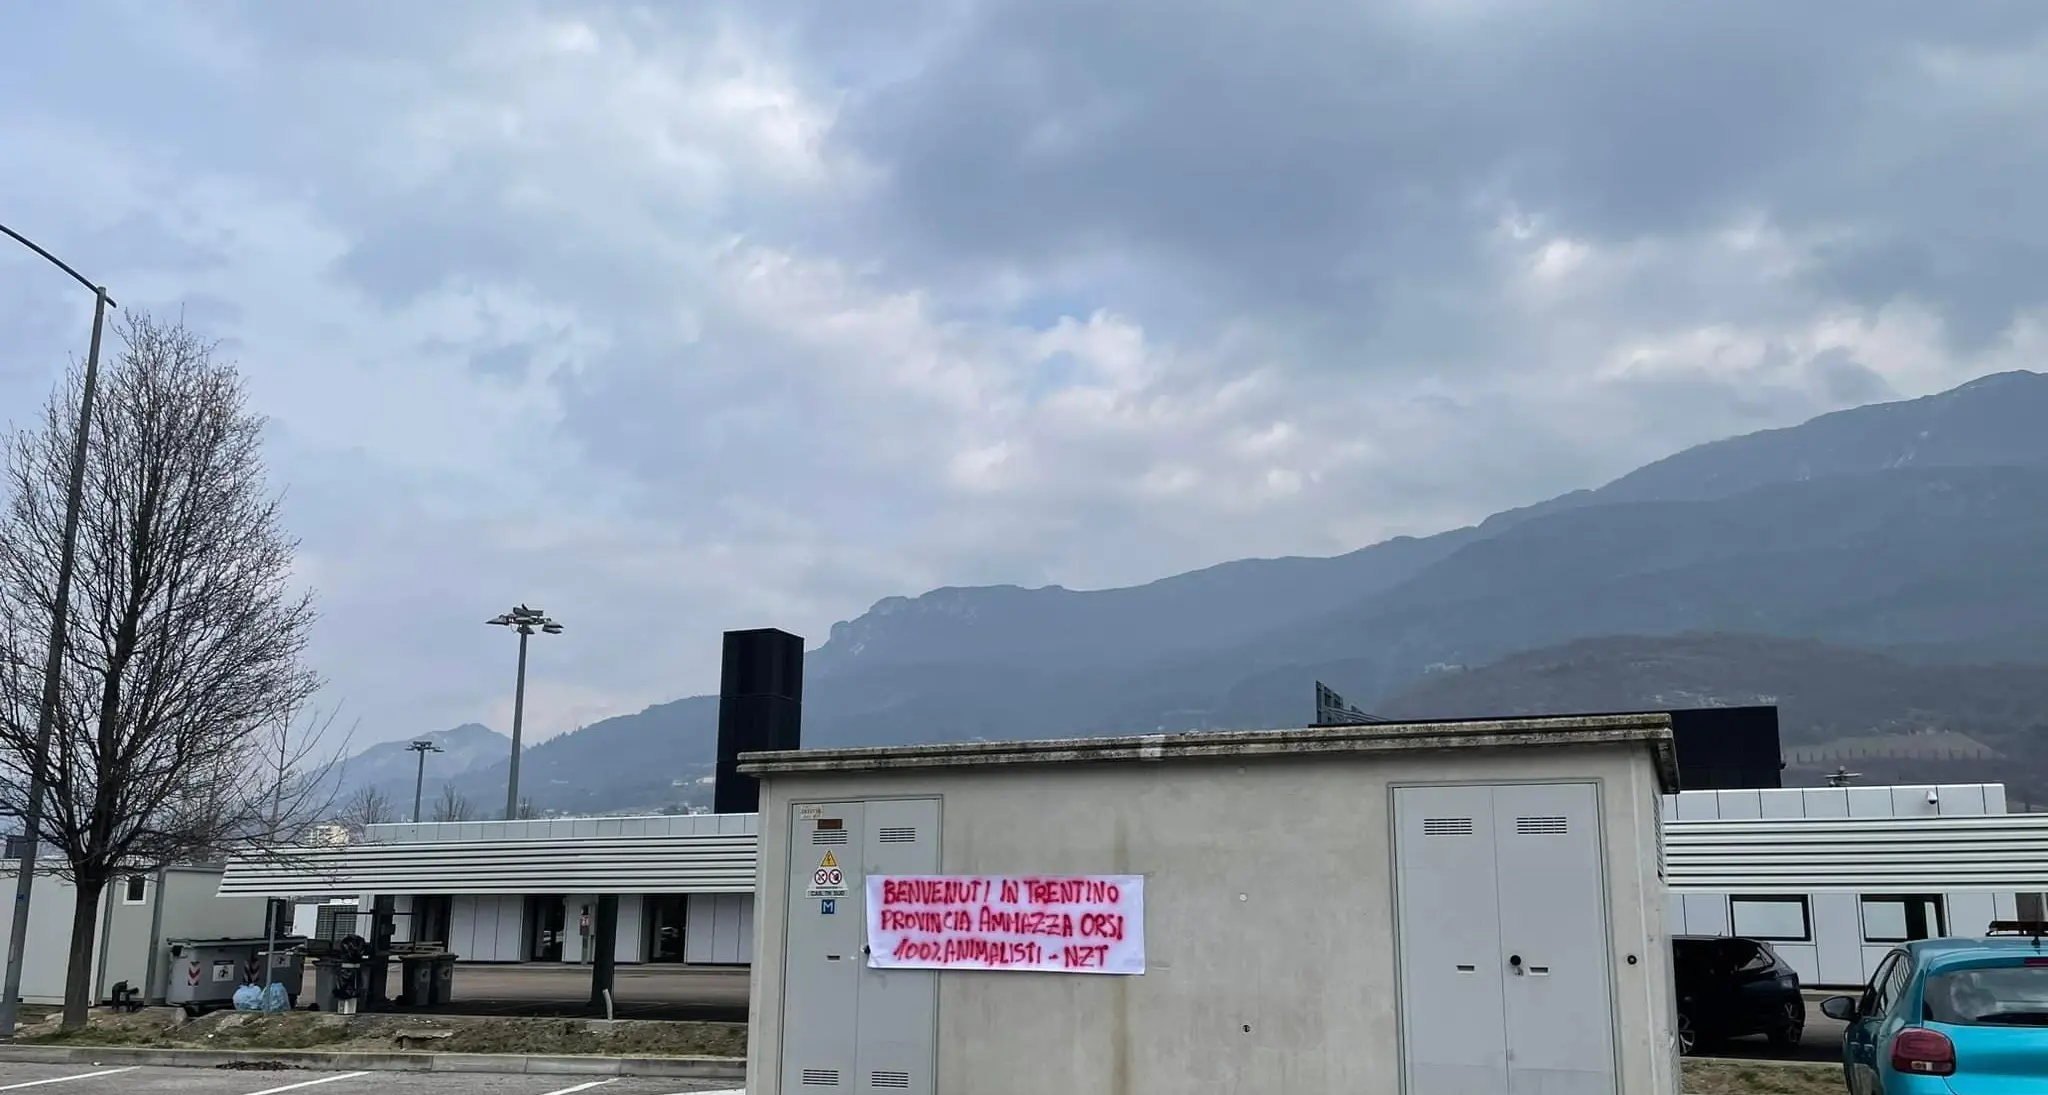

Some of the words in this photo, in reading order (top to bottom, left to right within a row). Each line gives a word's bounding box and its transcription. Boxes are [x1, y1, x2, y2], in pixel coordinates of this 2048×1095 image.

[883, 879, 991, 906] BENVENUTI
[999, 879, 1019, 905] IN
[1023, 879, 1120, 905] TRENTINO
[823, 901, 833, 913] M
[881, 909, 971, 934] PROVINCIA
[978, 904, 1073, 938] AMMAZZA
[1080, 912, 1124, 941] ORSI
[1064, 944, 1110, 968] NZT
